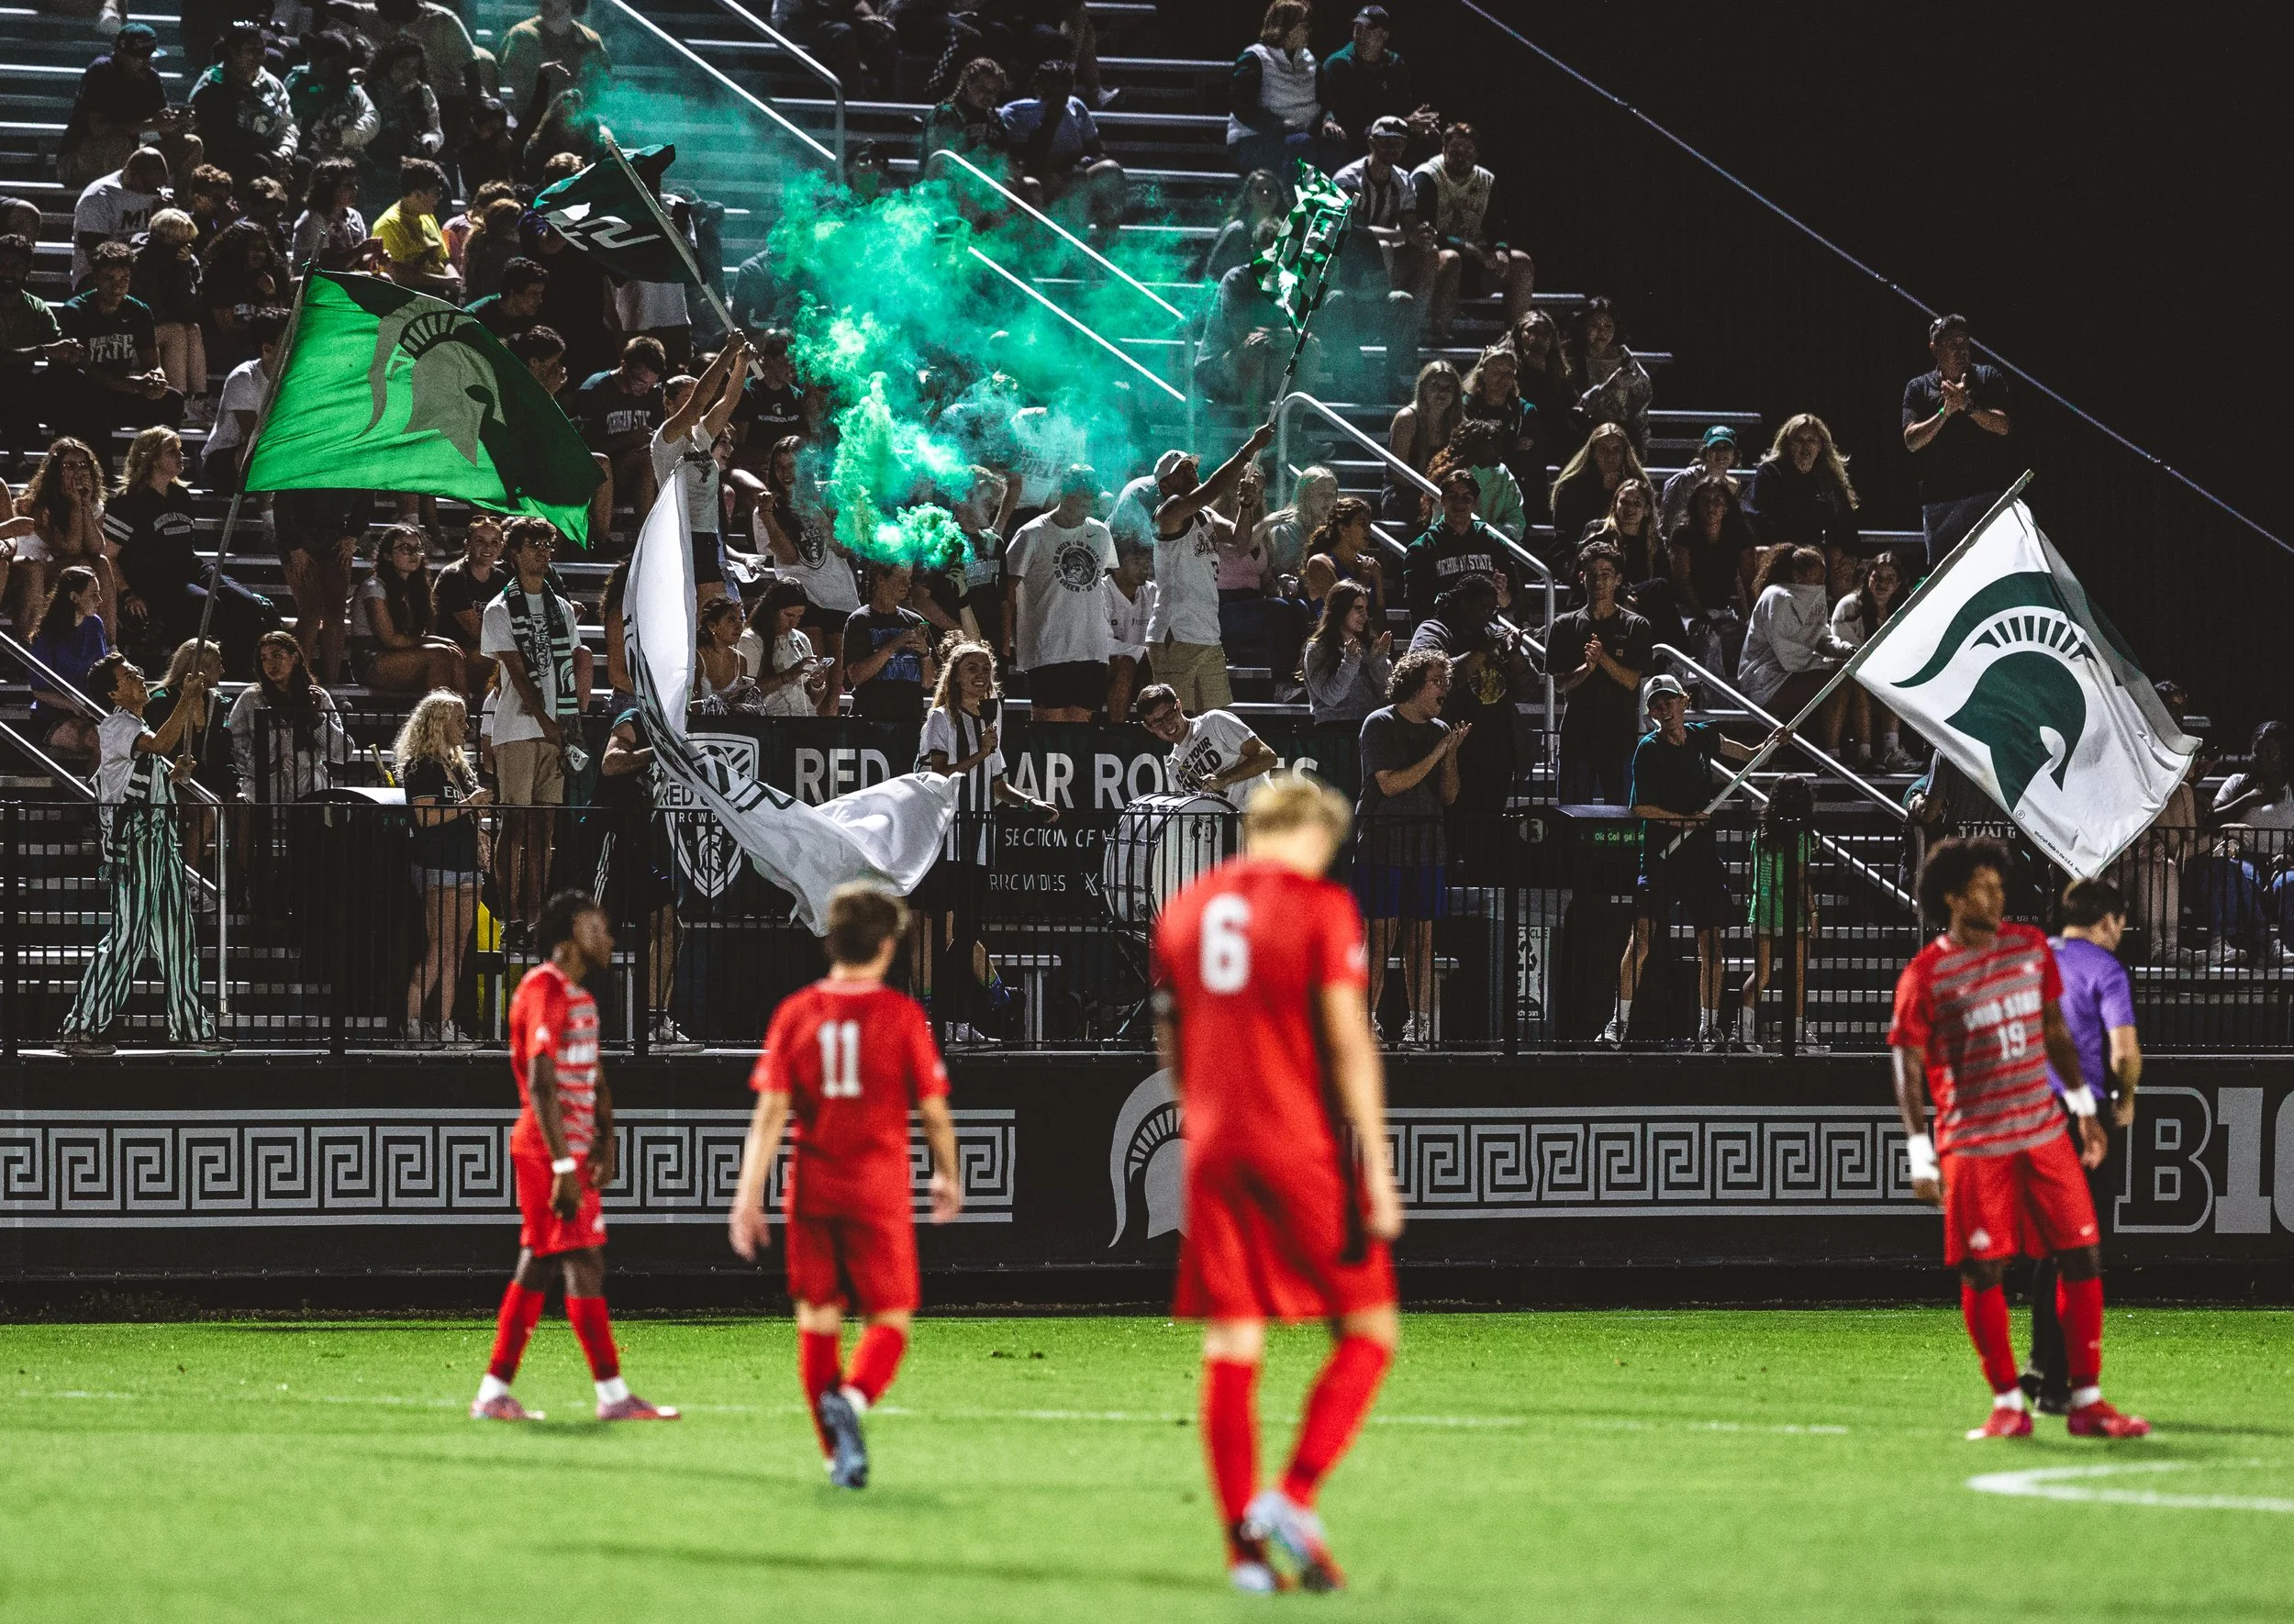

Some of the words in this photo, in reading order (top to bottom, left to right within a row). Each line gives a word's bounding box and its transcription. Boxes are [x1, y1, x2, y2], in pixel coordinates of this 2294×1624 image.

[1189, 736, 1213, 762] YOUR
[796, 748, 891, 804] RED
[679, 812, 718, 823] ROWD
[1005, 828, 1068, 848] SECTION
[1201, 894, 1250, 995] 6
[817, 1019, 863, 1098] 11
[1999, 1022, 2028, 1062] 19
